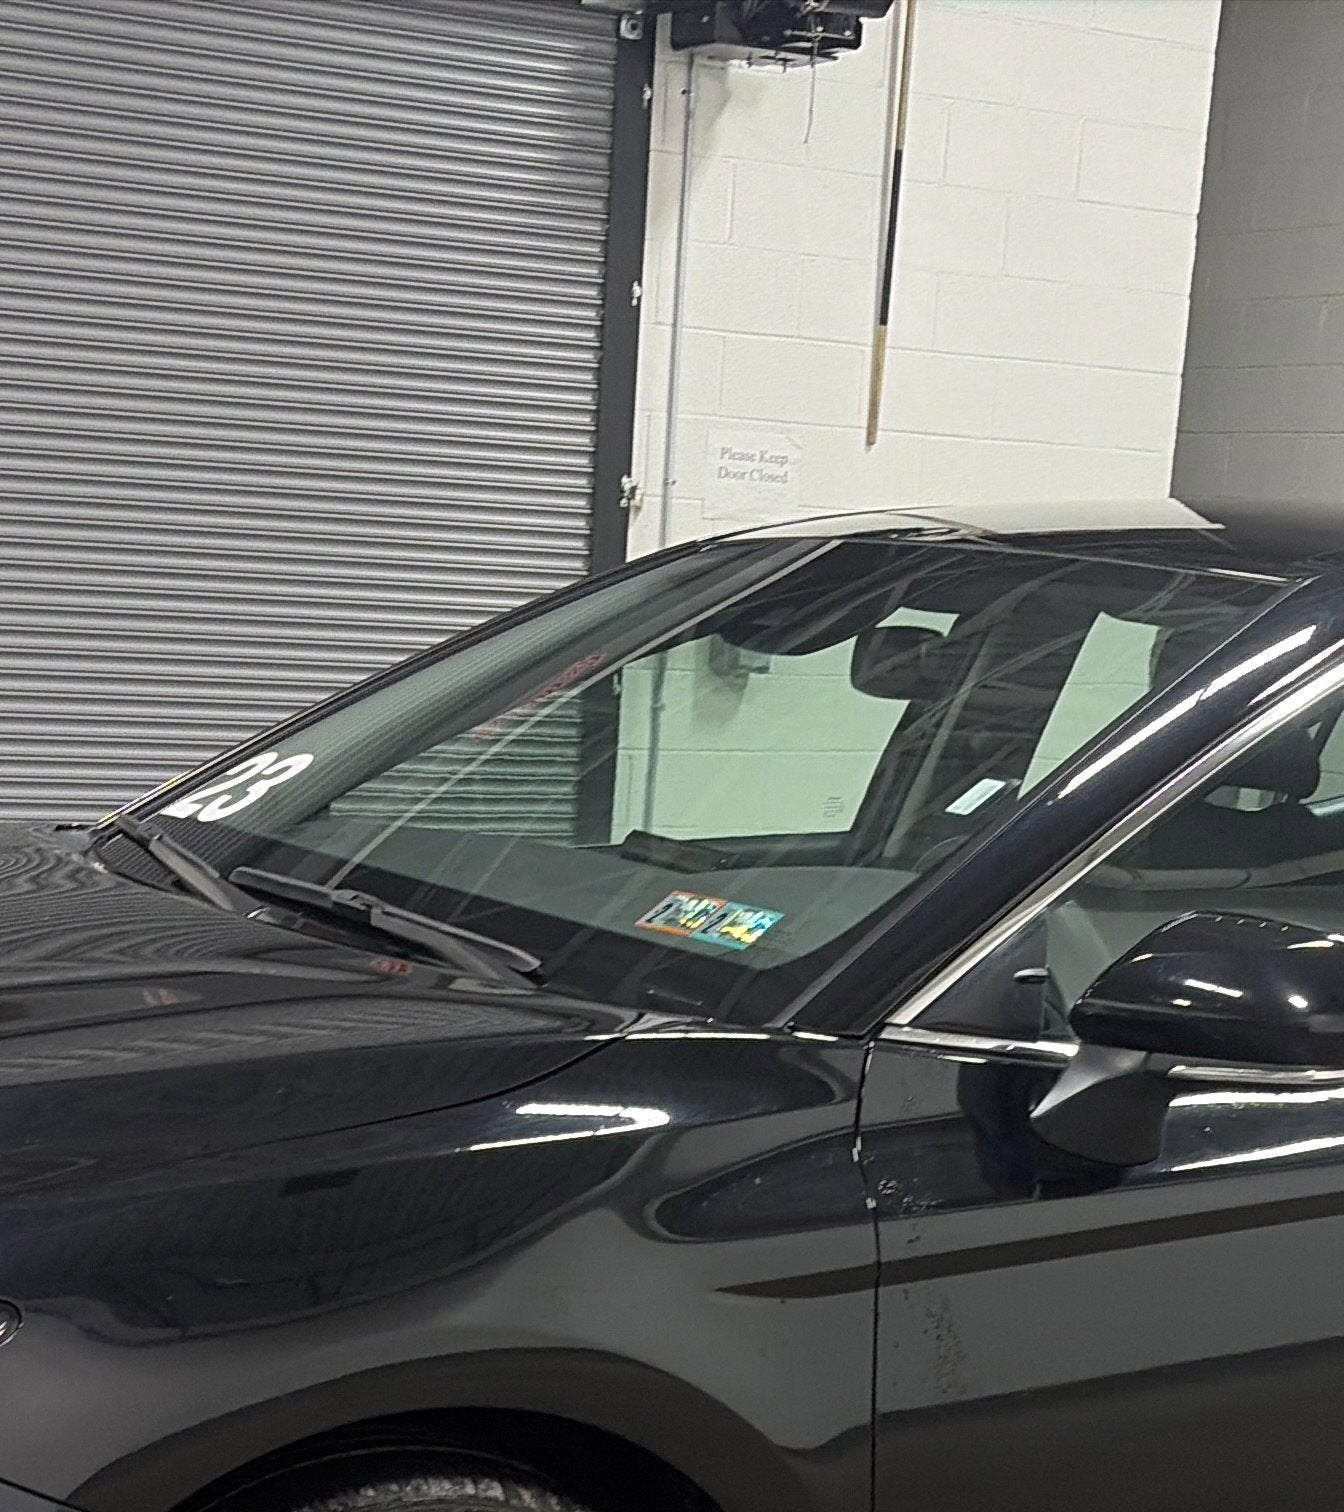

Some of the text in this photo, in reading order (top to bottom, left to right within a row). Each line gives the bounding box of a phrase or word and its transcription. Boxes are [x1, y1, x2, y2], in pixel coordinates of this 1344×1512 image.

[719, 446, 789, 468] Please Keep
[717, 465, 789, 484] Door Closed
[159, 751, 315, 823] 23
